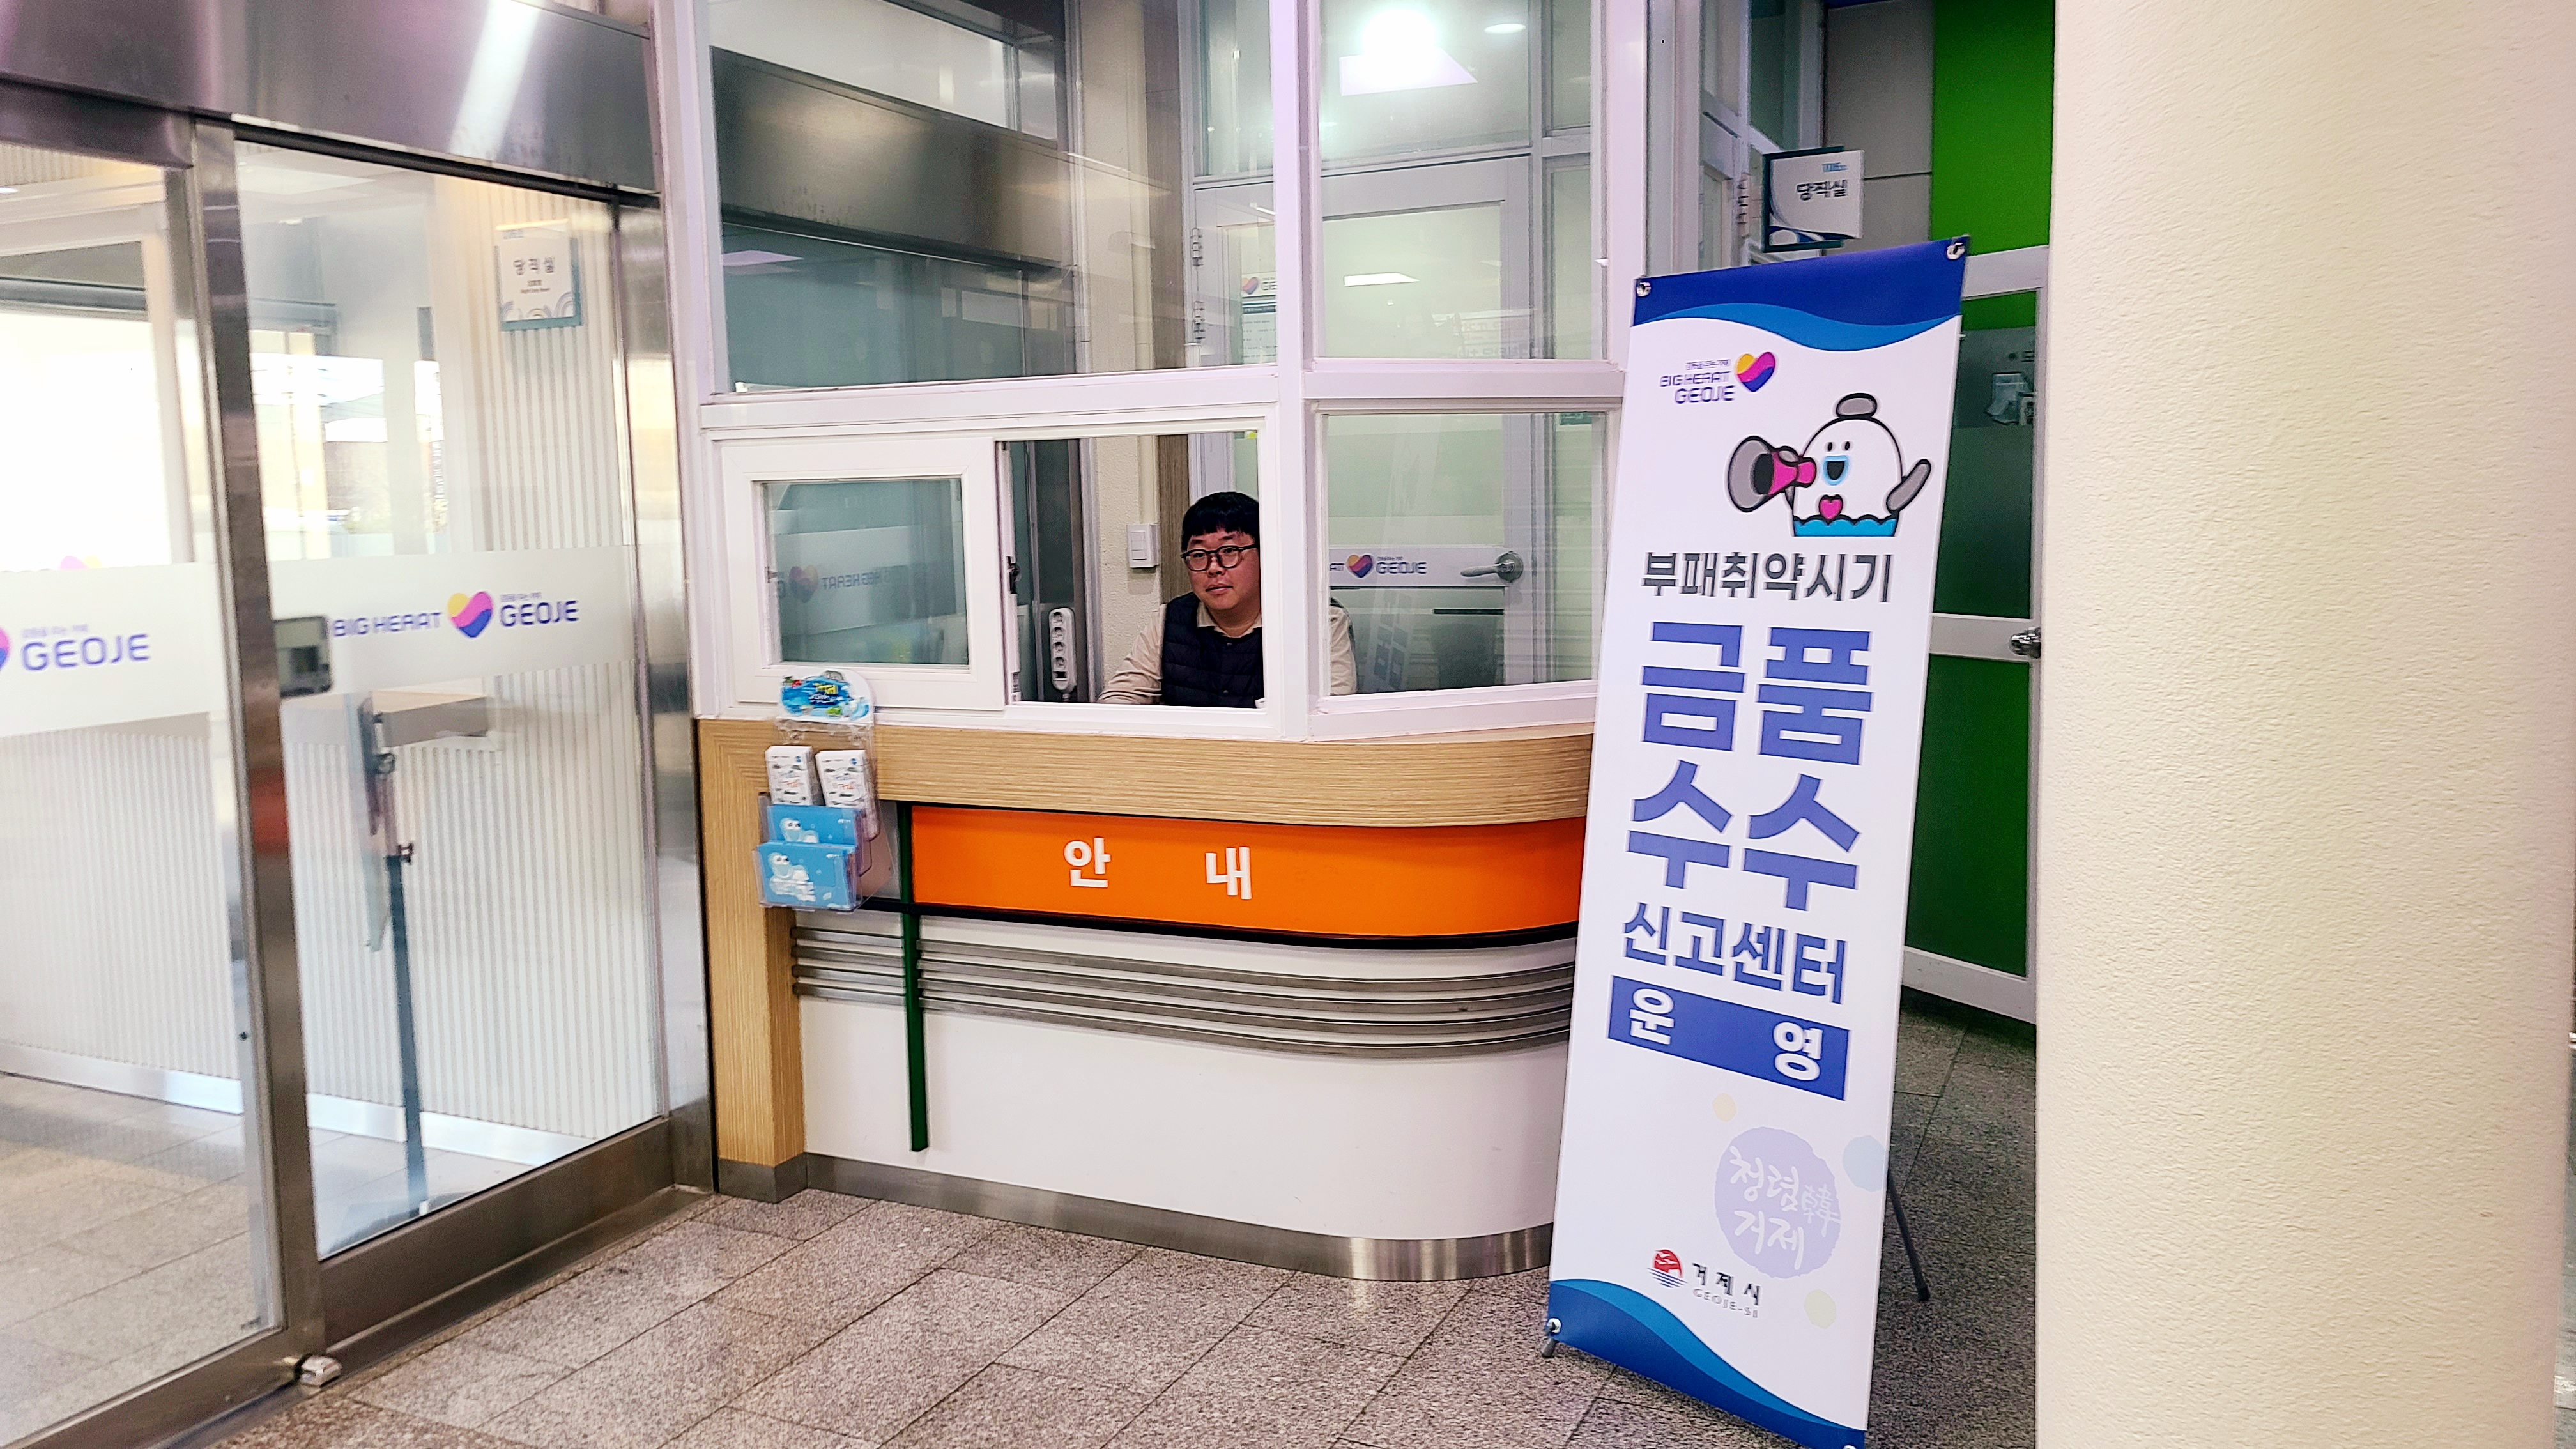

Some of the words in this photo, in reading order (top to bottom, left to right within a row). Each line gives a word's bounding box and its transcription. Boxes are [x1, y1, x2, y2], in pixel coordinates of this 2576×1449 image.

[1796, 180, 1849, 201] 당직실
[1675, 385, 1735, 404] GEOJE
[1641, 551, 1892, 602] 부패취약시기
[333, 618, 369, 637] BIG
[500, 600, 579, 627] GEOJE
[22, 633, 151, 671] GEOJE
[1639, 621, 1874, 765] 금품
[1626, 760, 1862, 911] 수수
[1621, 901, 1848, 1004] 신고센터
[1733, 1210, 1805, 1270] 거제
